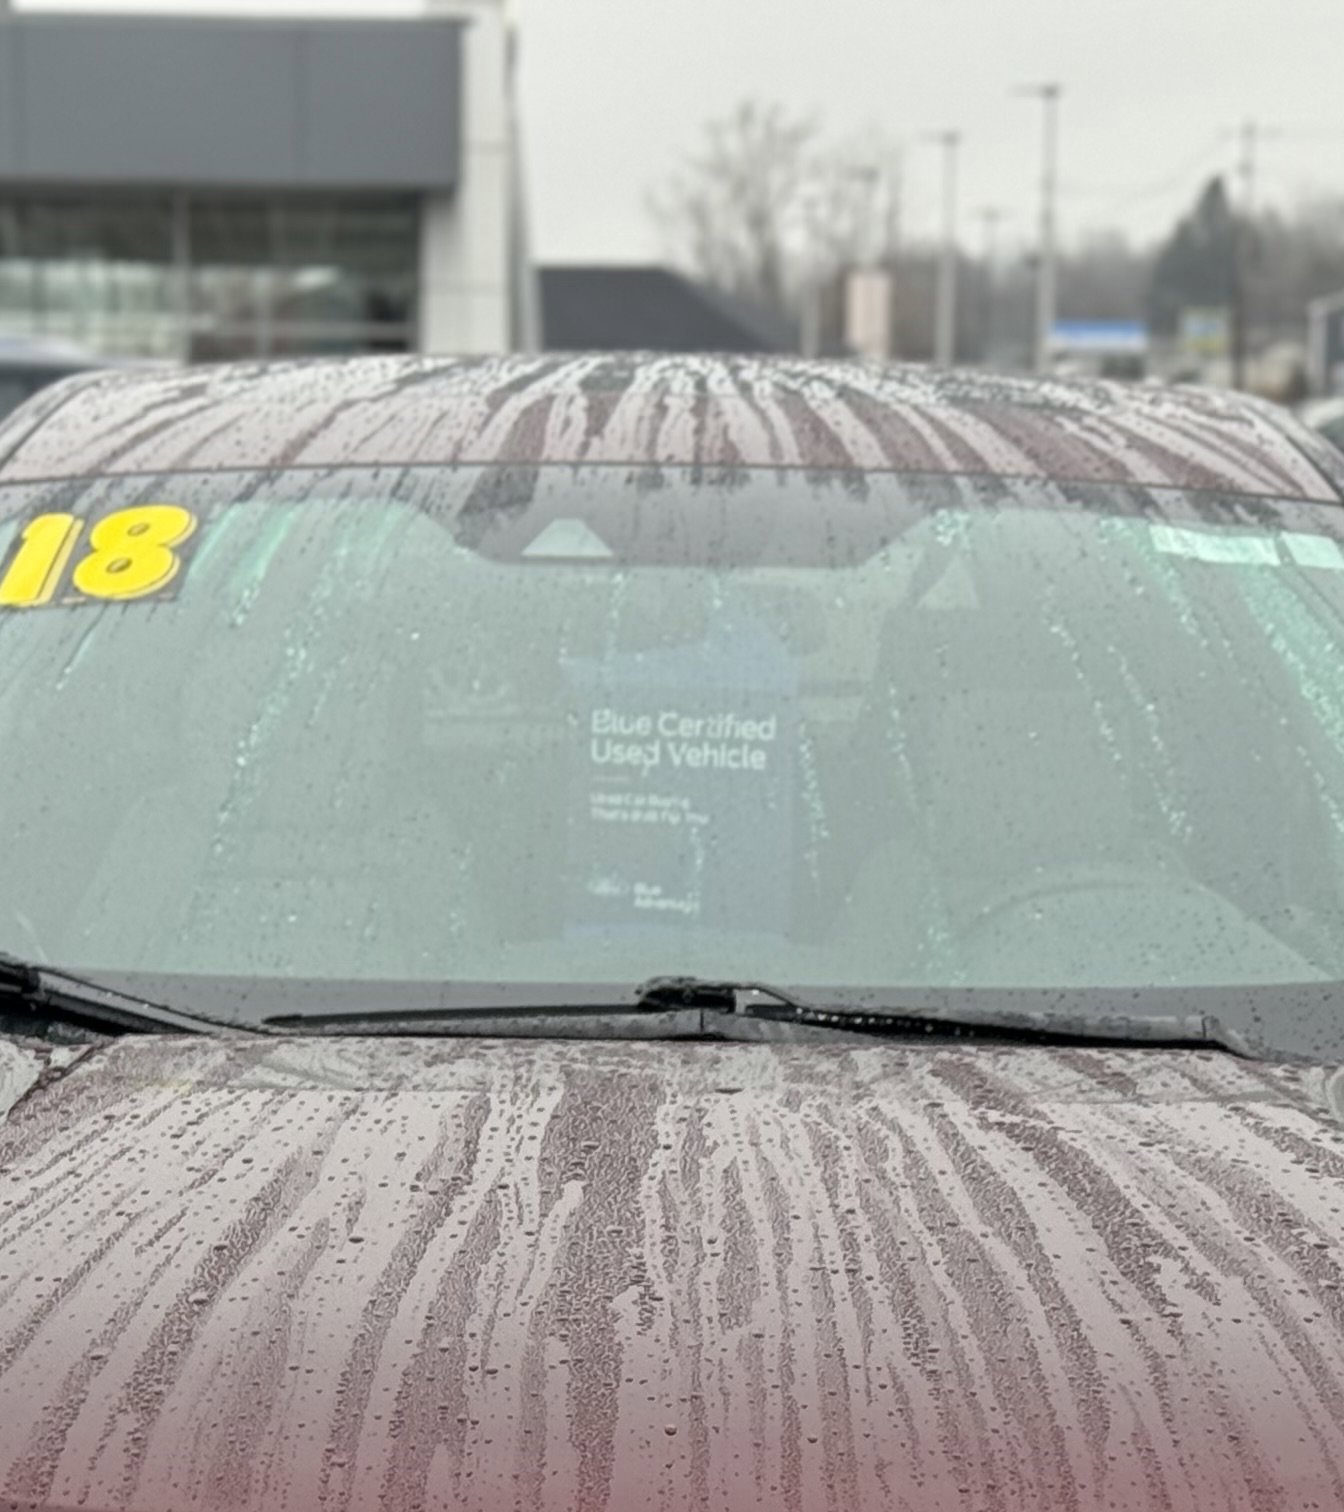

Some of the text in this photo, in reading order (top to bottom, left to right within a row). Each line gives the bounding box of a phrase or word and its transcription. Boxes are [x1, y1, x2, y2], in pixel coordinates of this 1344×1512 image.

[591, 709, 777, 740] Blue Certified
[591, 738, 767, 770] Used Vehicle
